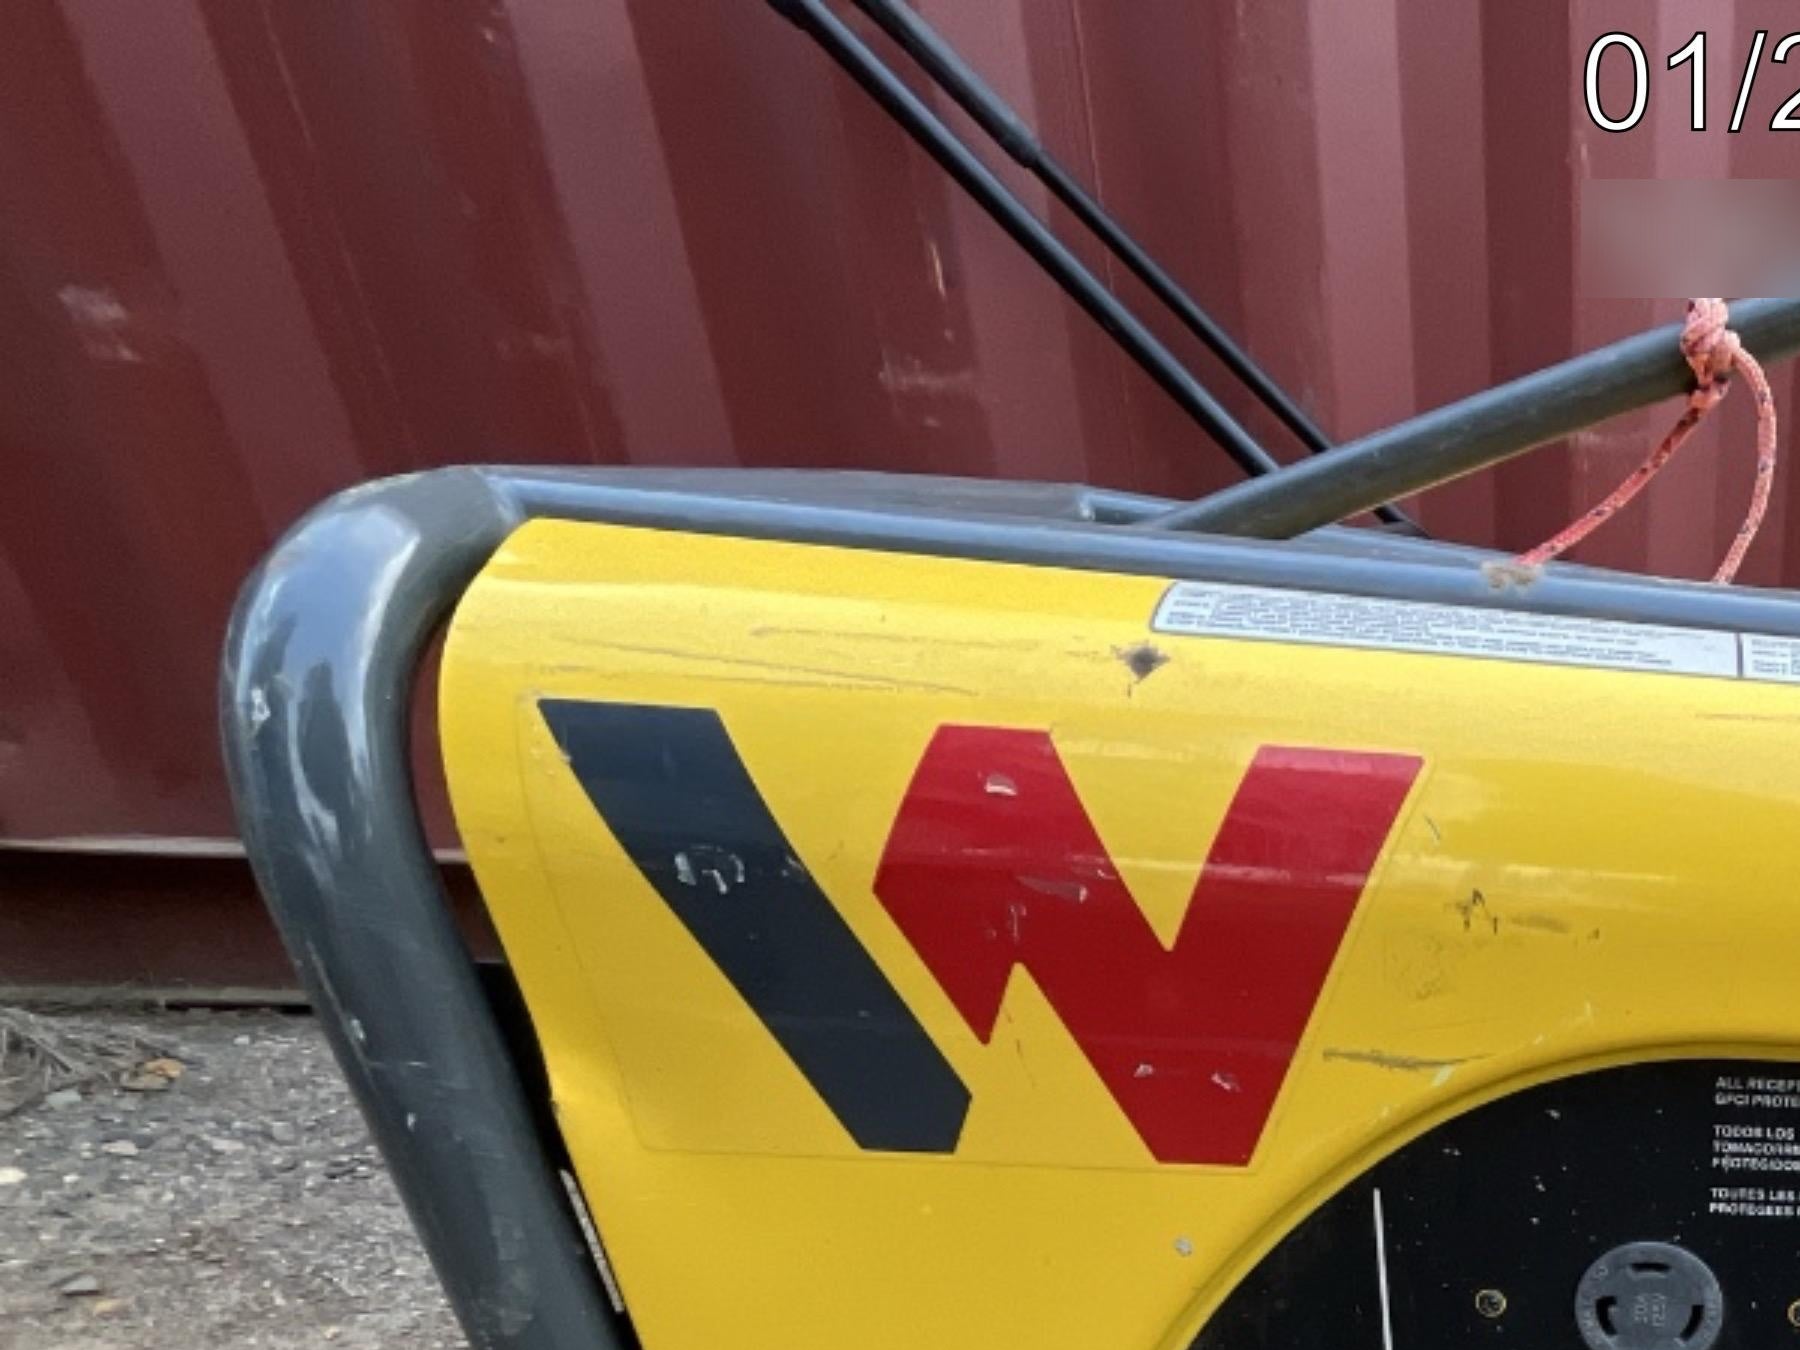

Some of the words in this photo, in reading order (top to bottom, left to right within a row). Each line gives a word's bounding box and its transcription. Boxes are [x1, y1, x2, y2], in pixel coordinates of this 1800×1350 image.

[1715, 1077, 1743, 1089] ALL
[1712, 1125, 1763, 1138] TODOS
[1766, 1127, 1795, 1141] LOS
